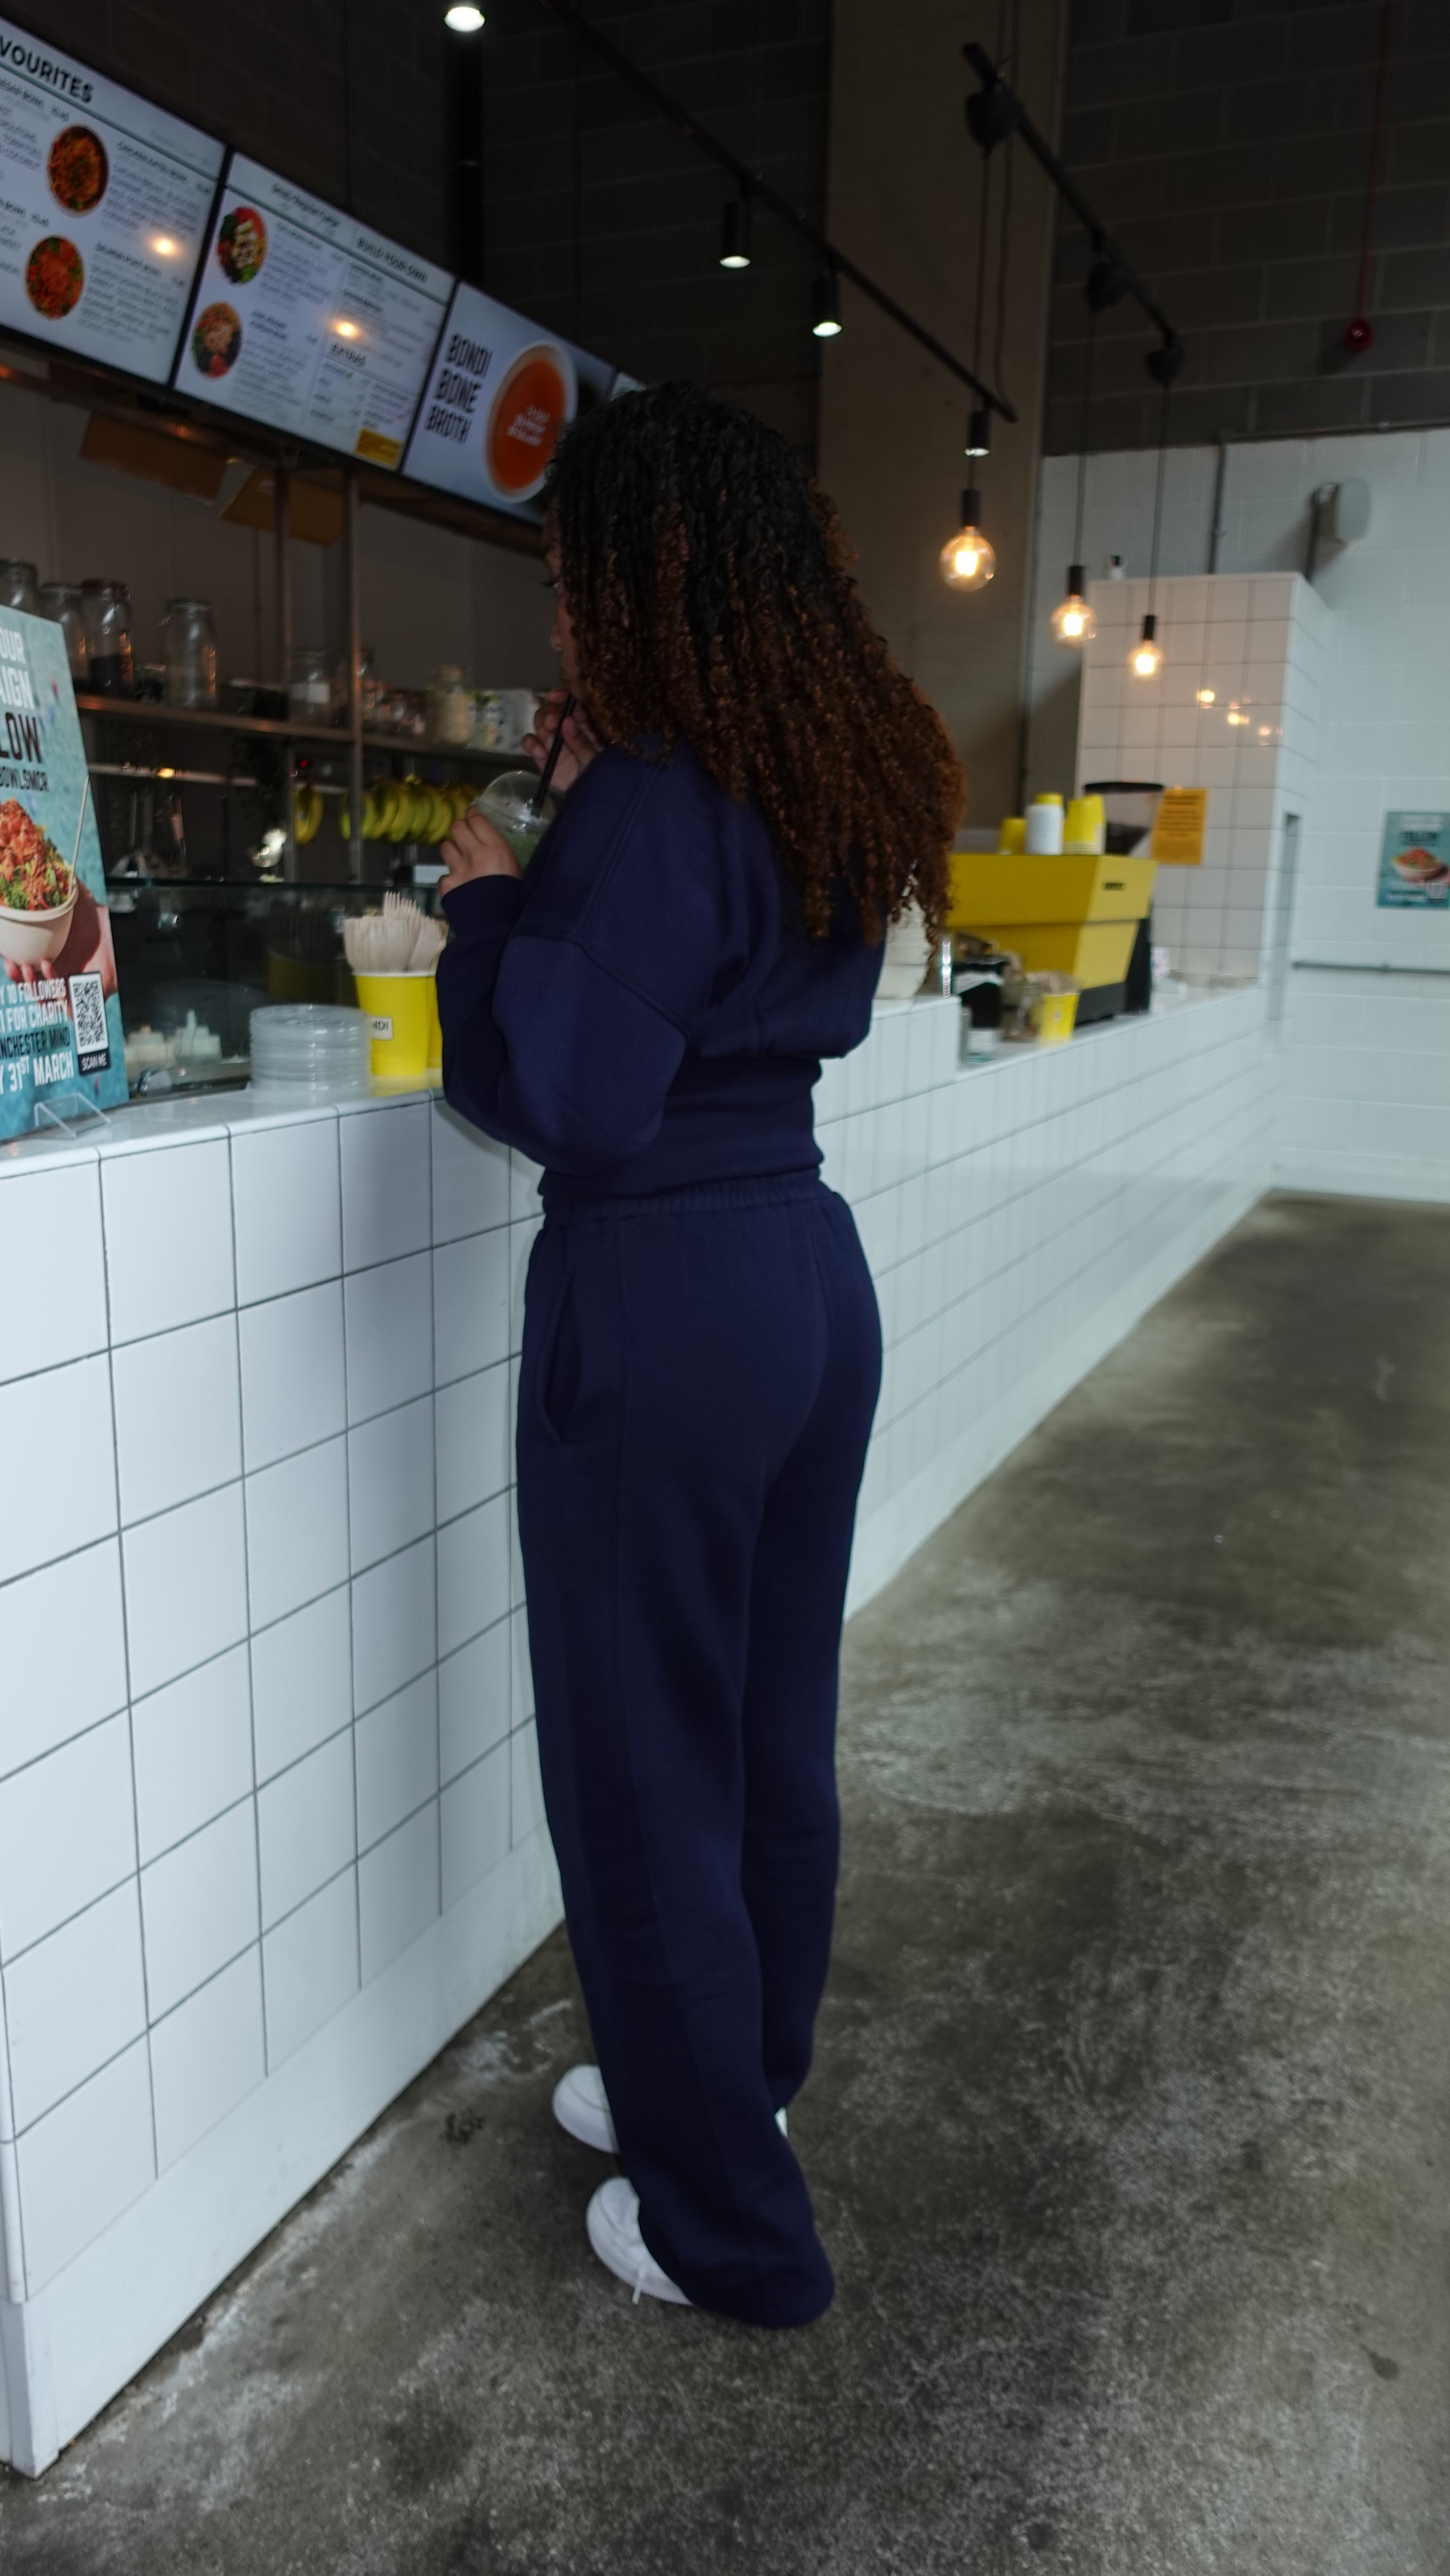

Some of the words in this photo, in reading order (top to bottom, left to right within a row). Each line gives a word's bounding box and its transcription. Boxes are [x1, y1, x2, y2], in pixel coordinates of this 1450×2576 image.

[0, 35, 94, 103] VOURITES
[446, 333, 493, 378] BONDI
[435, 368, 482, 414] BONE
[425, 406, 472, 444] BROTH
[18, 977, 66, 1003] FOLLOWERS
[6, 1006, 27, 1033] FOR
[28, 999, 68, 1028] CHARITY
[49, 1026, 71, 1050] MIND
[33, 1050, 74, 1087] MARCH
[81, 1054, 98, 1071] SCAN
[98, 1052, 107, 1067] ME
